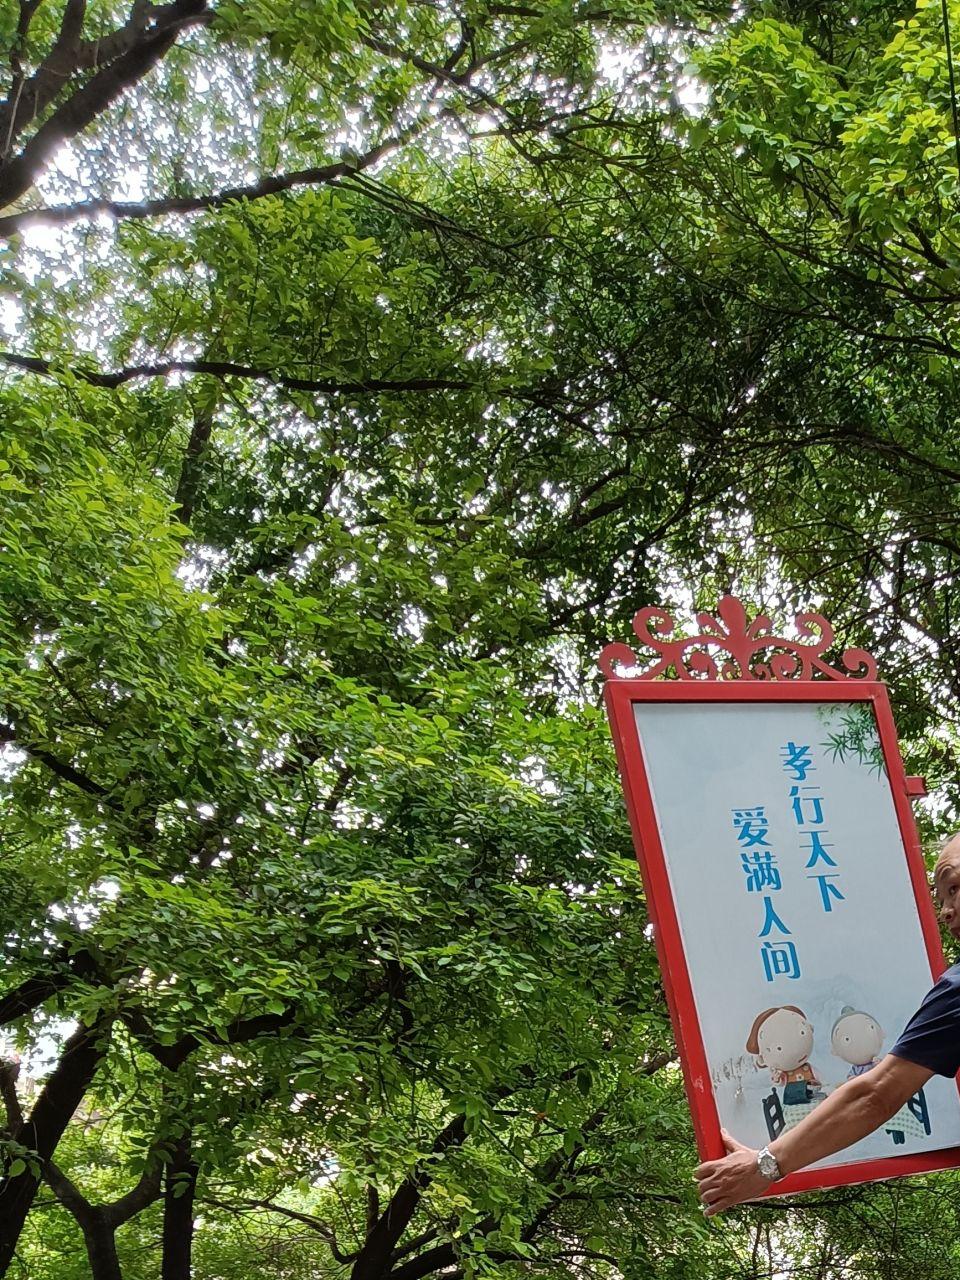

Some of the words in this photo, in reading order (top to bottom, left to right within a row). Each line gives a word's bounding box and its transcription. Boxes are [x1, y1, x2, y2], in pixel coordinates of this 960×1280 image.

[731, 806, 802, 982] 爱满人间
[780, 742, 845, 912] 孝行天下
